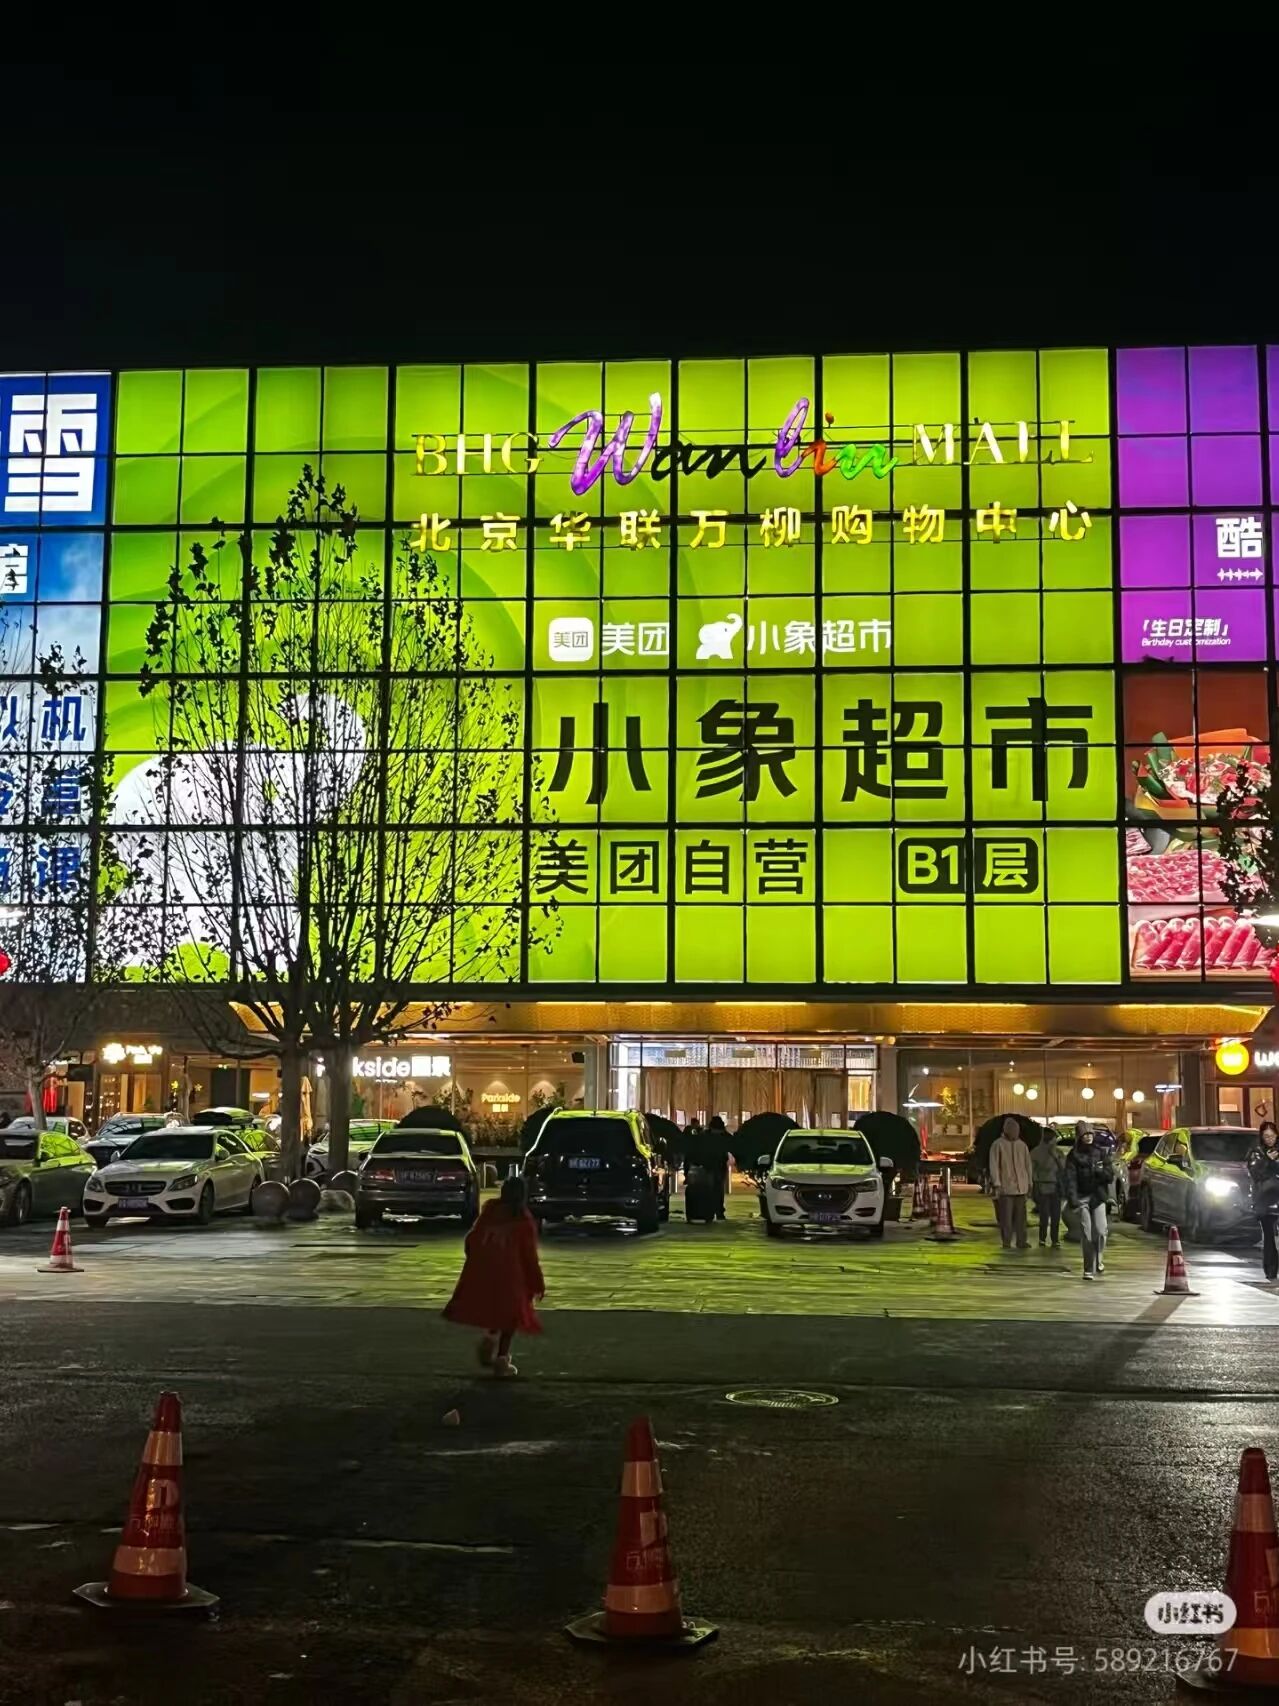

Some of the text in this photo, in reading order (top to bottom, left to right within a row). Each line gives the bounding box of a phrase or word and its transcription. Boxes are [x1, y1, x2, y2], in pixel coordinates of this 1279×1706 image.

[416, 391, 1093, 496] BHG Wanlin MALL
[411, 501, 1092, 552] 北京华联万柳购物中心
[1216, 516, 1263, 558] 酷
[553, 631, 589, 648] 美团
[602, 622, 669, 656] 美团
[747, 619, 892, 654] 小象超市
[1141, 637, 1175, 648] Birthday
[548, 697, 1094, 805] 小象超市
[534, 838, 809, 895] 美团自营
